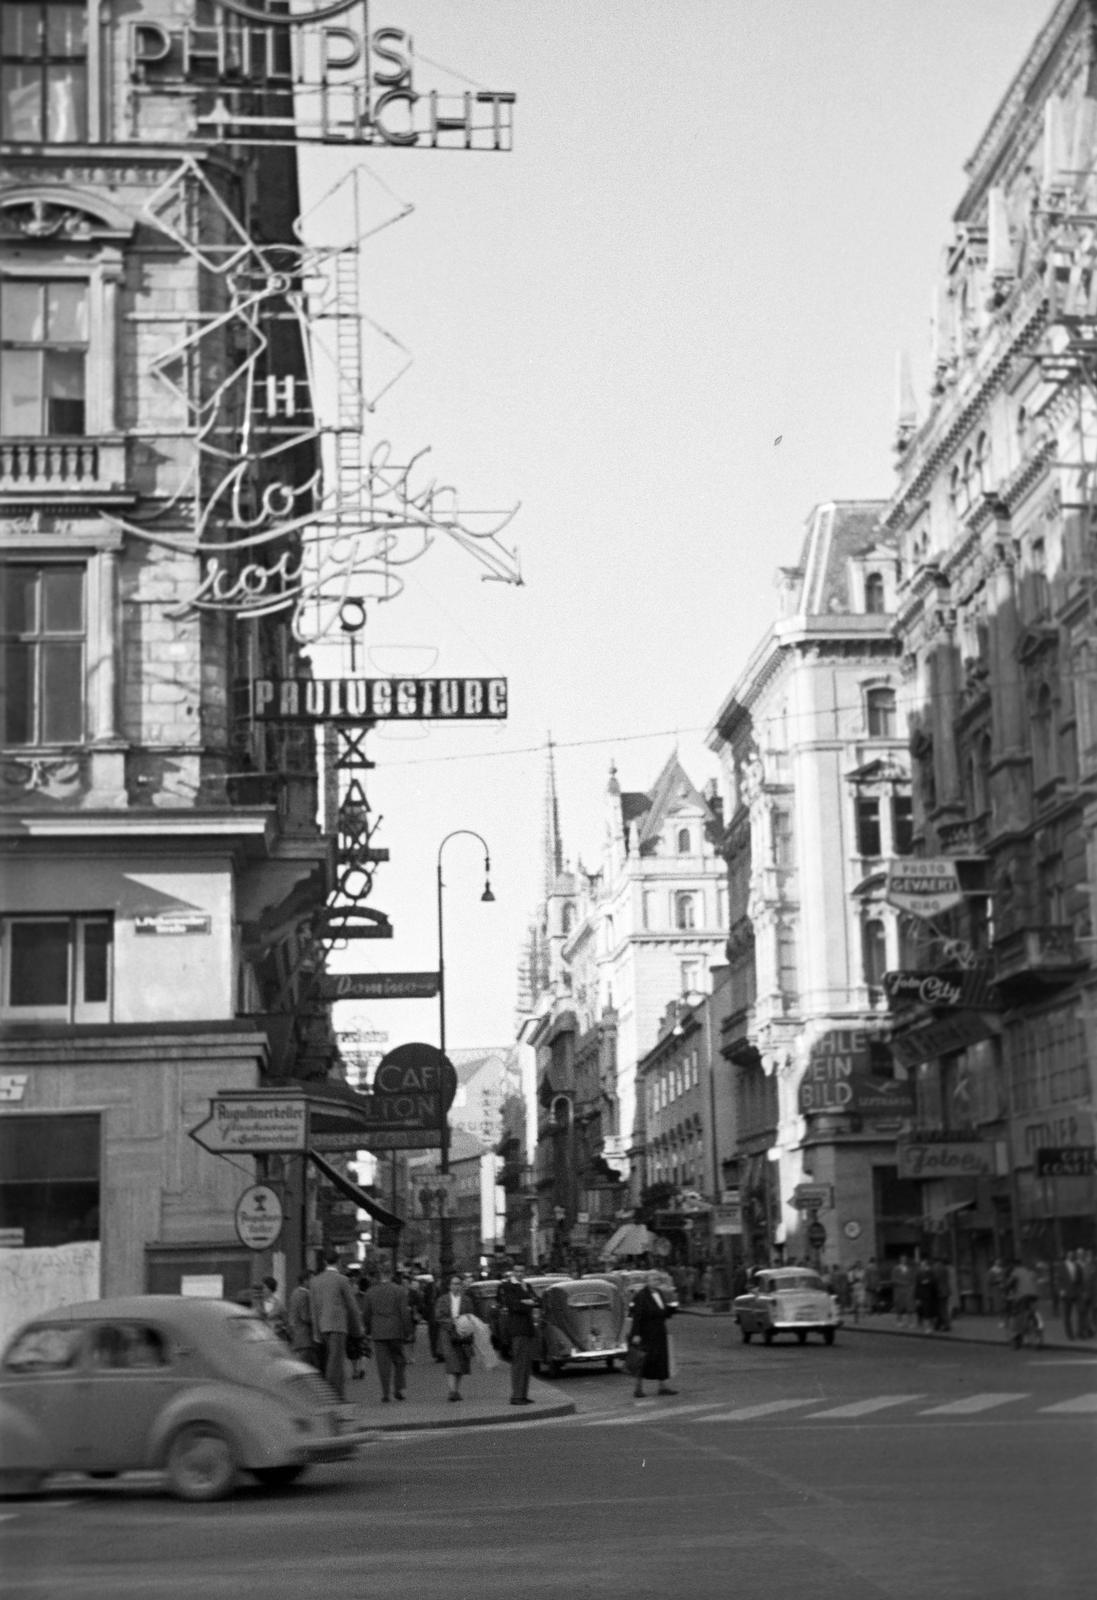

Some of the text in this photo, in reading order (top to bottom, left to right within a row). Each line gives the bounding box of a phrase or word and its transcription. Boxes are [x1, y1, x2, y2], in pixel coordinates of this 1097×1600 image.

[322, 88, 517, 149] LICHT
[255, 679, 506, 716] PAULUSSTUBE
[902, 863, 946, 875] PHOTO
[892, 879, 955, 892] GEVAERT
[815, 1031, 867, 1054] HLE
[801, 1082, 854, 1107] BILD
